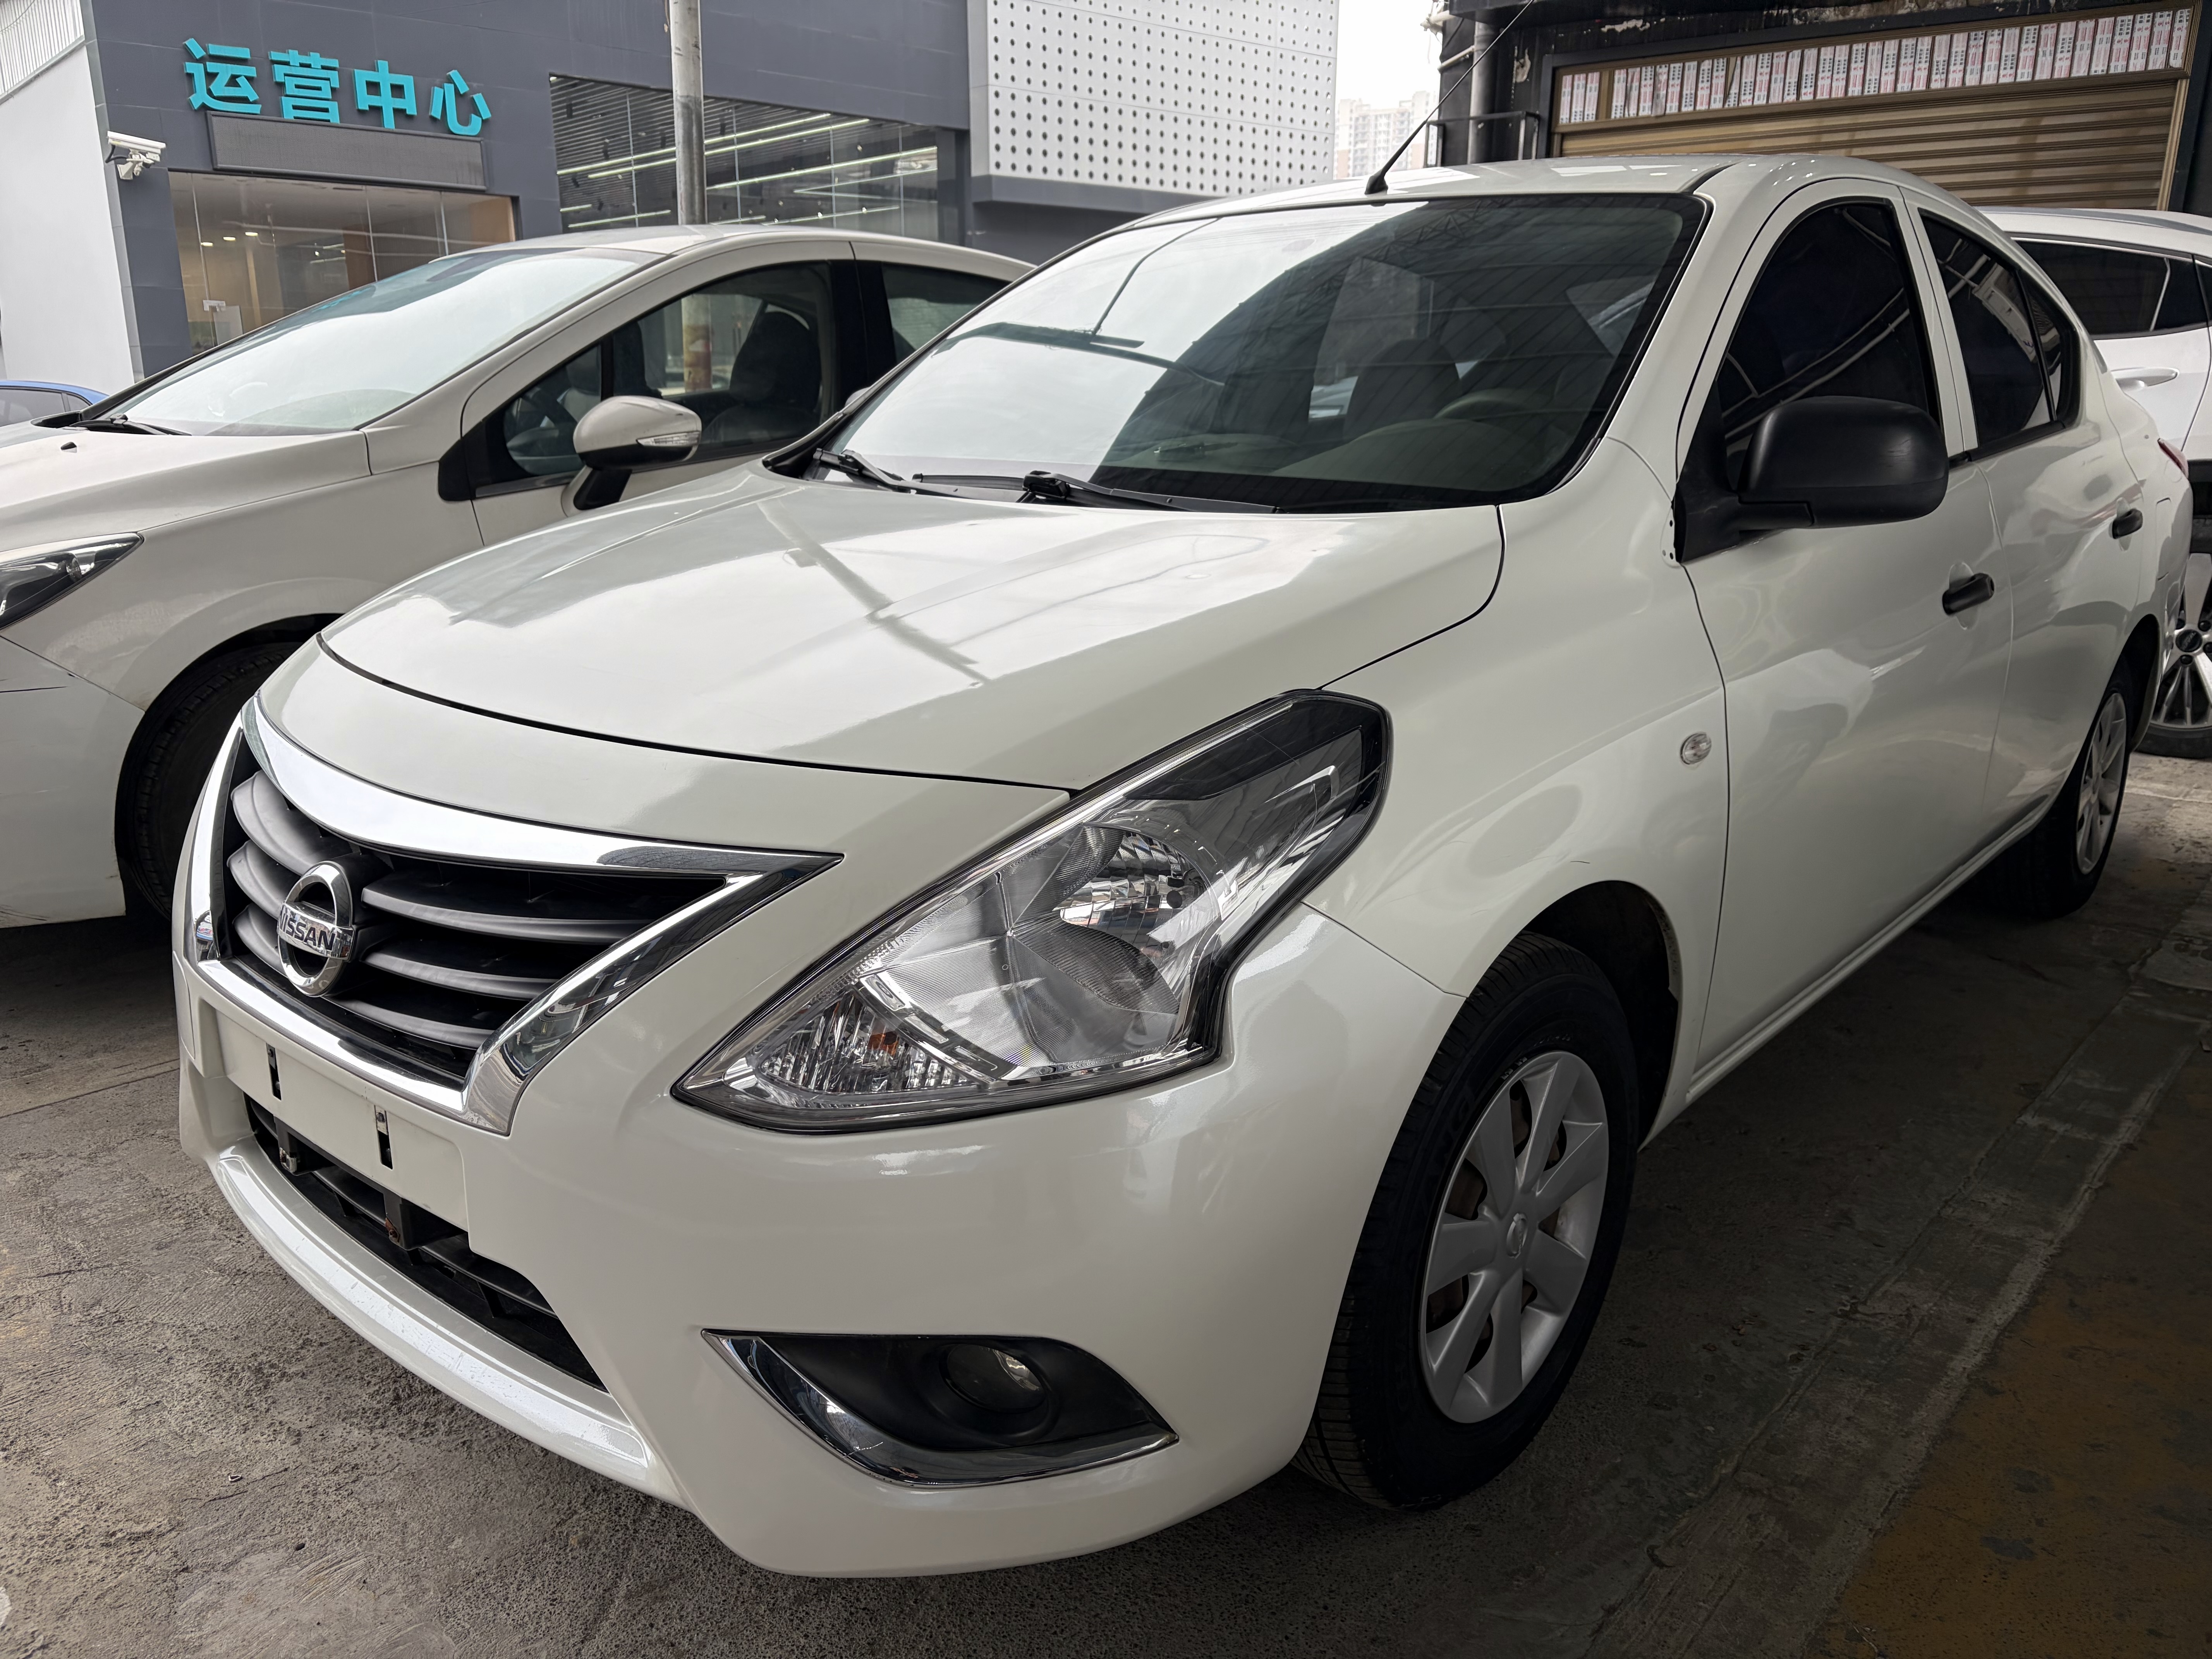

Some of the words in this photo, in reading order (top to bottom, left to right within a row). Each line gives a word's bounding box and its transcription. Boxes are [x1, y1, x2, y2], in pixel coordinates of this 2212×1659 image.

[184, 38, 491, 136] 运营中心
[280, 909, 336, 951] NISSAN
